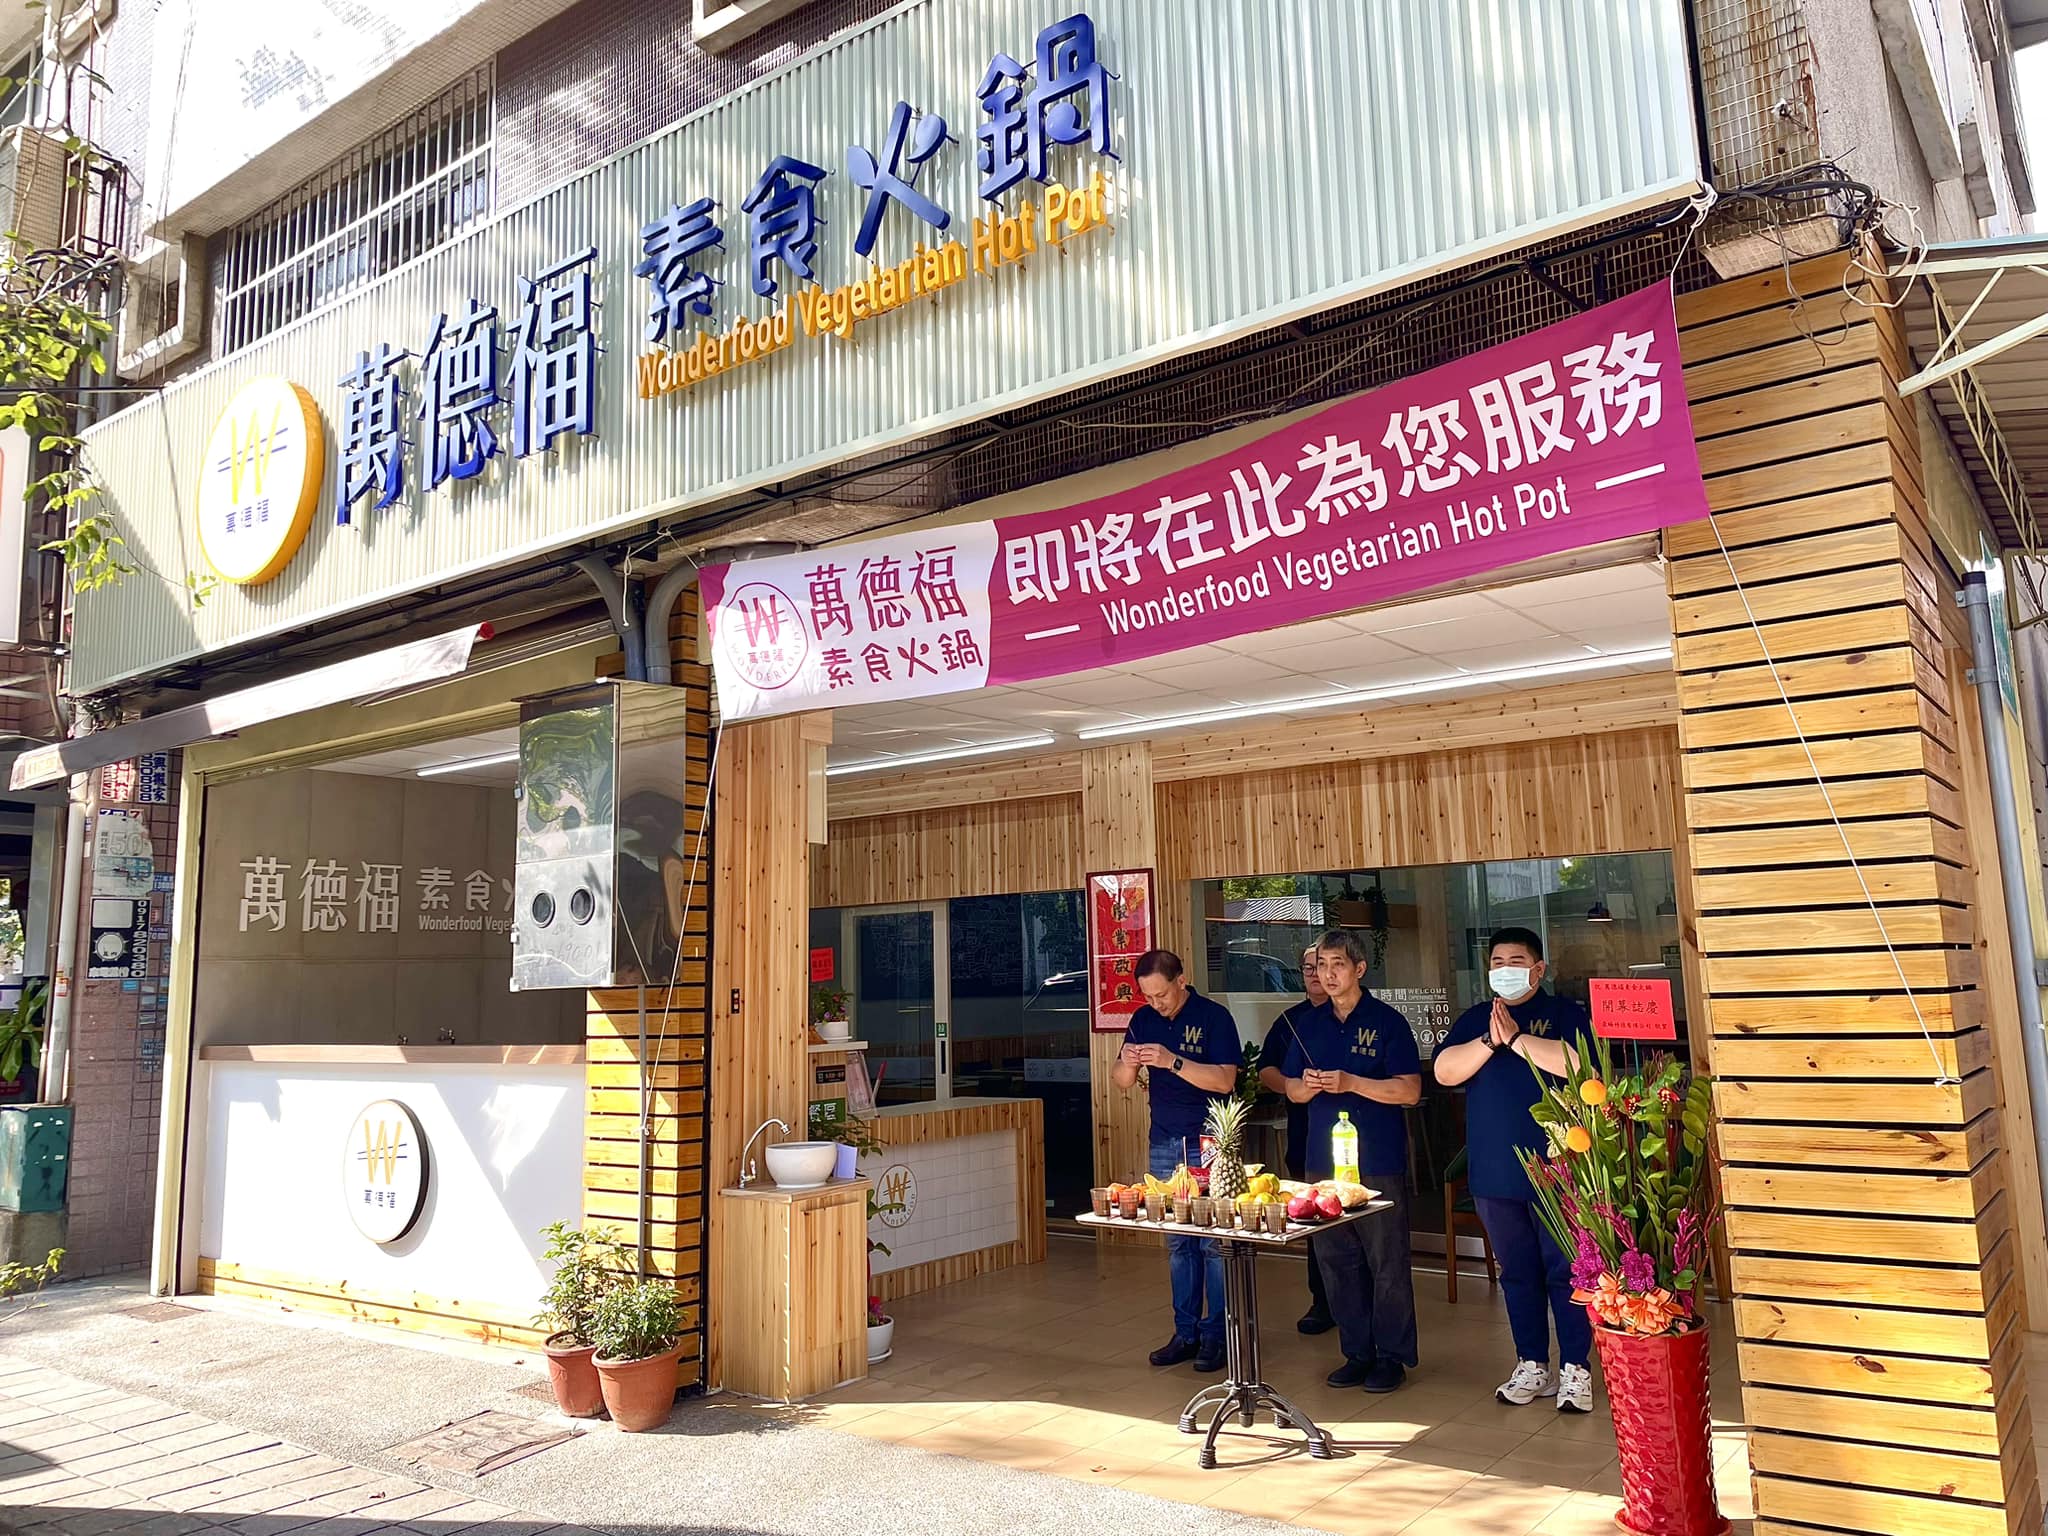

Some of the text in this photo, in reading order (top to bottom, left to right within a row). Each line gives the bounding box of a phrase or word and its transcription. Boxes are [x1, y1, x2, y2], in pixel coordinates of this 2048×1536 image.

[633, 13, 1112, 344] 素食火鍋
[636, 171, 1109, 398] Wonderfood Vegetarian Hot Pot
[337, 246, 598, 526] 萬德福
[1004, 329, 1663, 605] 即將在此為您服務
[804, 545, 968, 641] 萬德福
[1100, 475, 1571, 636] Wonderfood Vegetarian Hot Pot
[821, 629, 983, 689] 素食火鍋
[130, 900, 148, 978] 0917820380
[239, 856, 404, 934] 萬德福
[418, 915, 482, 932] Wonderfood
[1408, 987, 1447, 995] WELCOME
